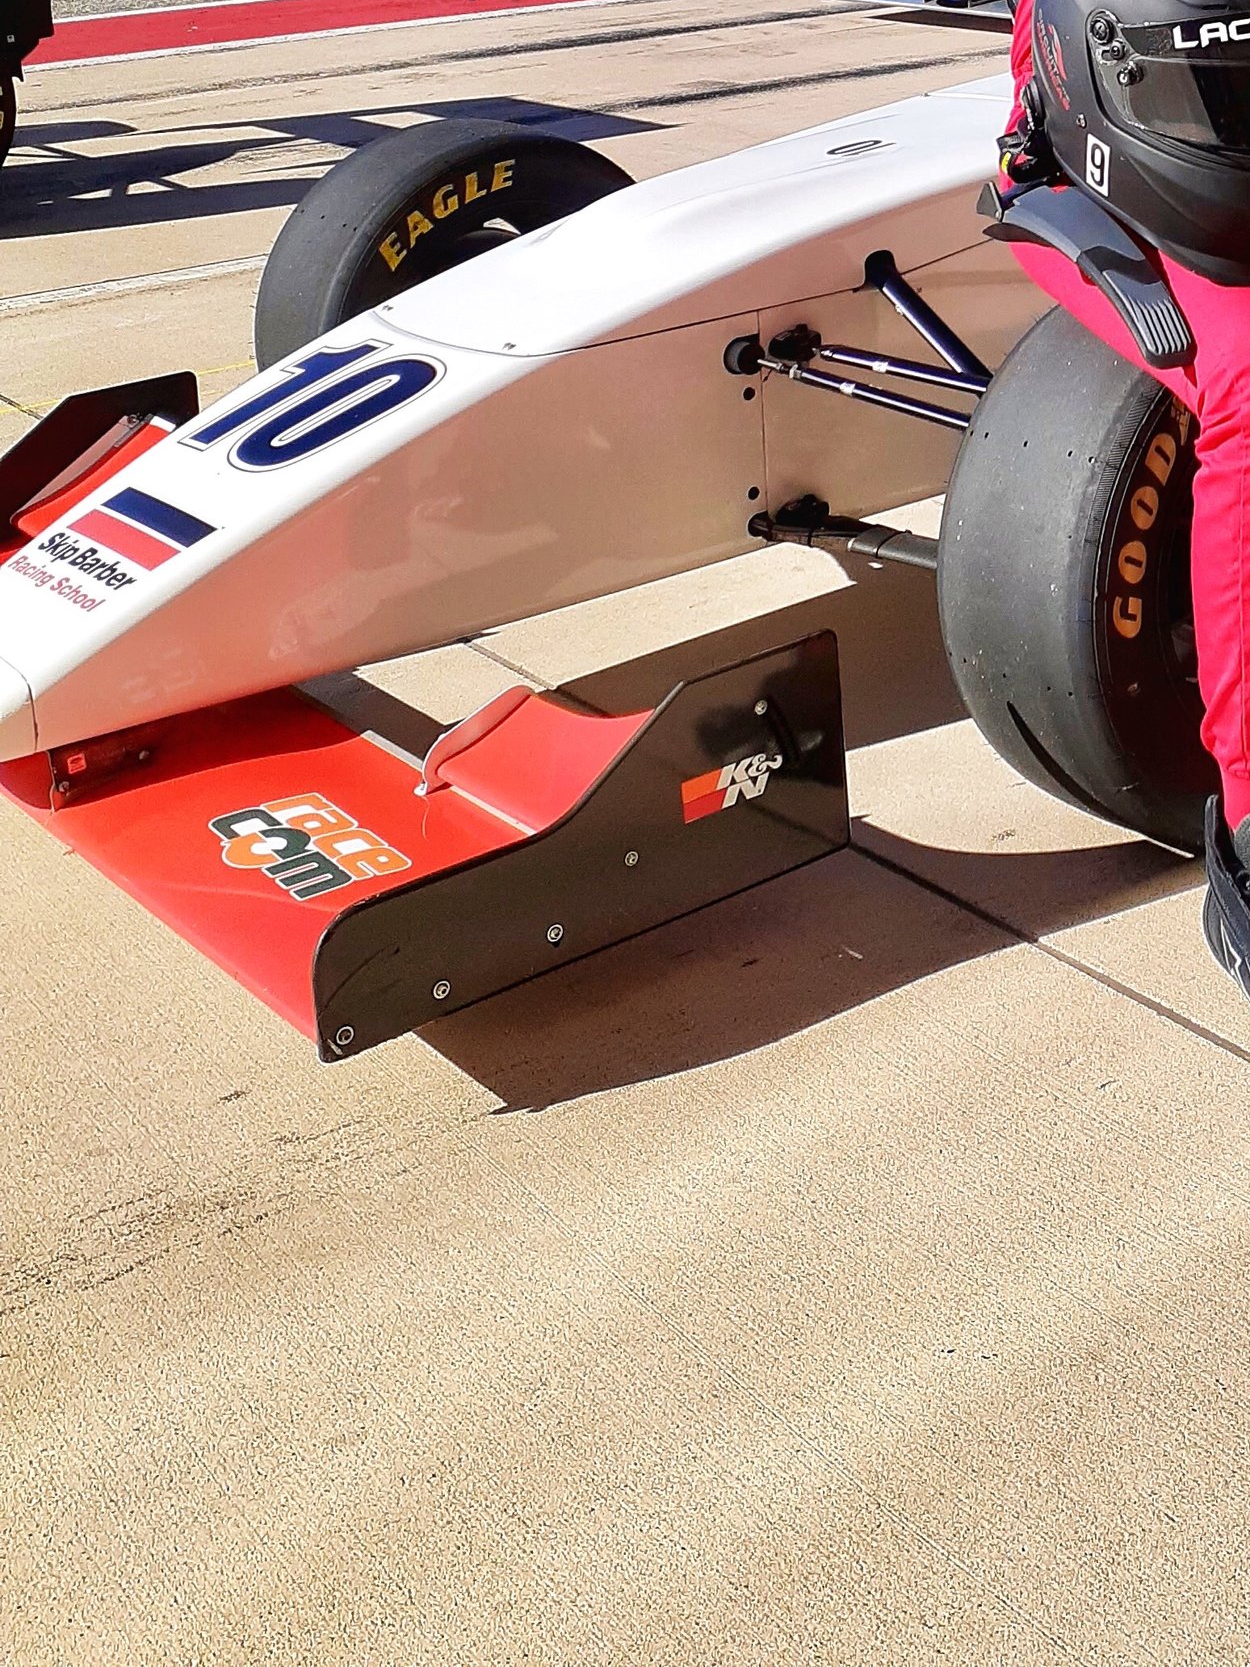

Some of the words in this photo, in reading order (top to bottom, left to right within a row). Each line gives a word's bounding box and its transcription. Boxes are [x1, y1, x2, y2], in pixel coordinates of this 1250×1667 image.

[1090, 142, 1106, 187] 9
[378, 158, 516, 272] EAGLE
[178, 340, 446, 472] 10
[7, 555, 56, 588] Racing
[49, 577, 107, 612] School
[38, 532, 80, 563] Skip
[68, 547, 138, 591] Barber
[260, 792, 413, 881] race
